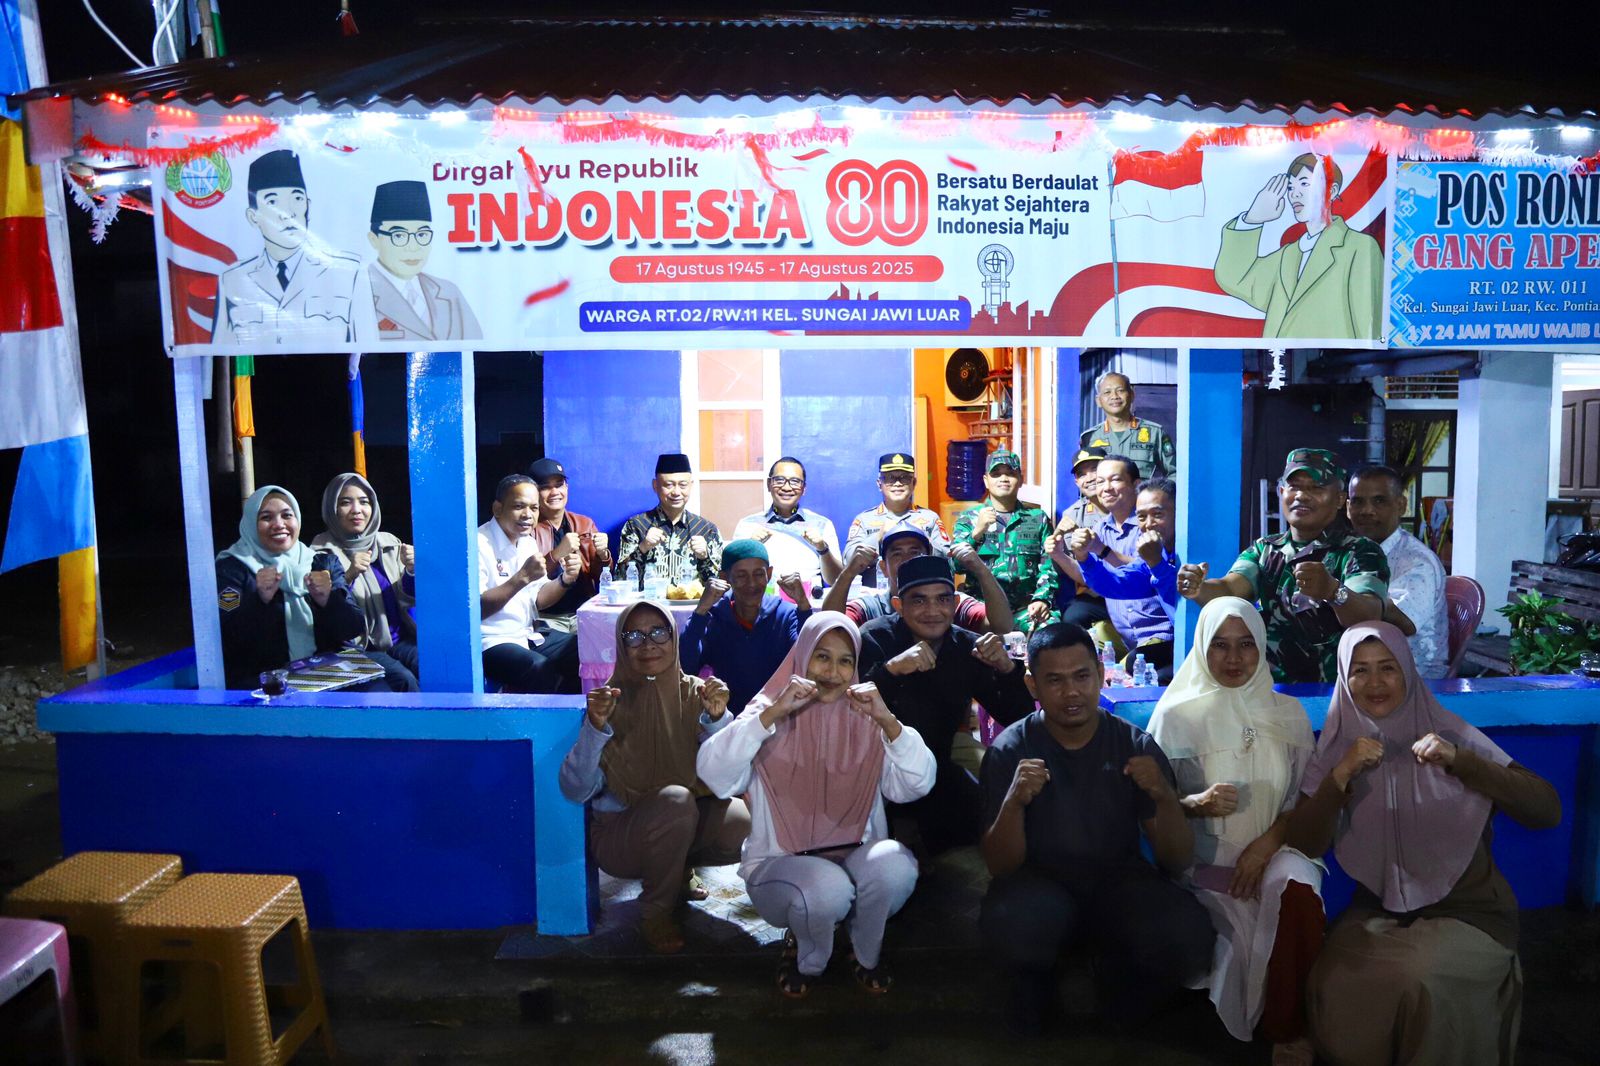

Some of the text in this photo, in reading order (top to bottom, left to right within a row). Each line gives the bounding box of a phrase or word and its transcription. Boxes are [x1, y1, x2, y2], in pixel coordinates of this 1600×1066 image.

[433, 157, 699, 186] Dirgahyu Republik
[937, 173, 1099, 191] Bersatu Berdaulat
[825, 158, 929, 247] 80
[937, 195, 1090, 216] Rakyat Sejahtera
[1436, 172, 1505, 226] POS
[447, 189, 808, 244] INDONESIA
[937, 217, 1069, 239] Indonesia Maju
[1413, 233, 1600, 269] GANG APE
[635, 263, 651, 276] 17
[655, 262, 724, 279] Agustus
[727, 262, 764, 275] 1945
[780, 262, 796, 275] 17
[799, 262, 868, 278] Agustus
[872, 261, 914, 275] 2025
[1469, 280, 1587, 295] RT. 02 RW. 011
[585, 308, 961, 323] WARGA RT.02/RW.11 KEL. SUNGAI JAWI LUAR
[1403, 301, 1600, 316] Kel. Sungai Jawi Luar, Kec. Pontia
[1420, 325, 1432, 340] X
[1435, 325, 1454, 340] 24
[1457, 324, 1490, 339] JAM
[1494, 324, 1540, 339] TAMU
[1543, 323, 1591, 338] WAJIB
